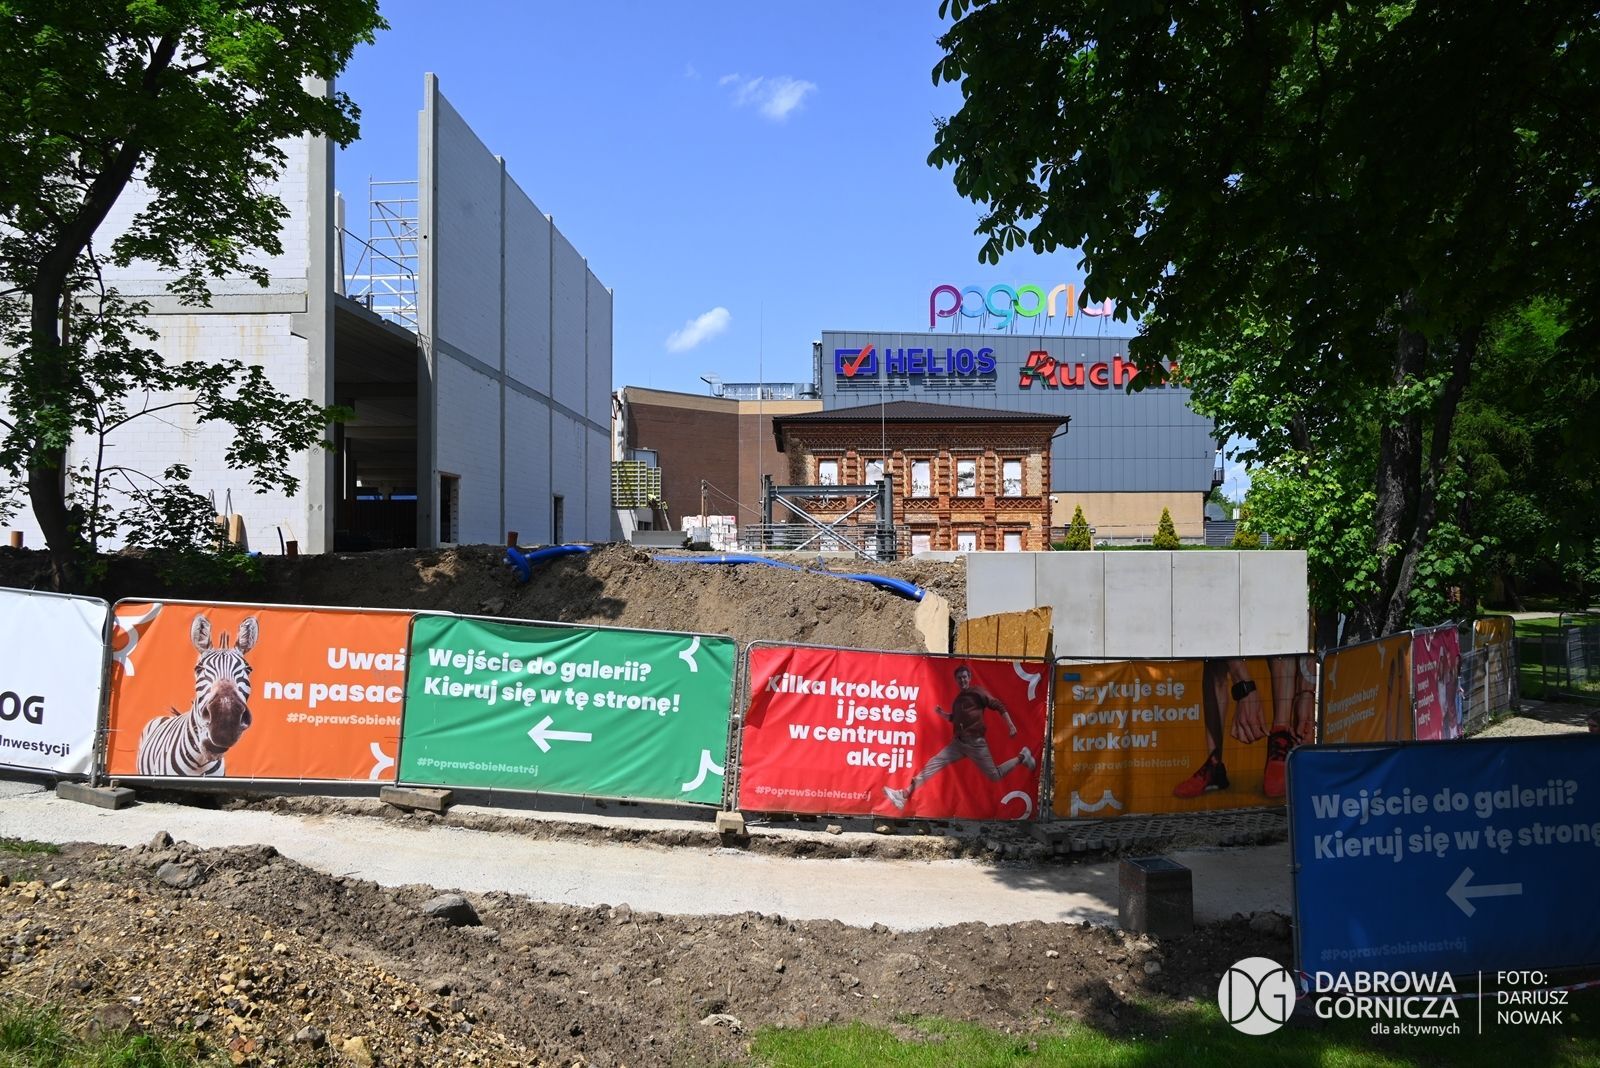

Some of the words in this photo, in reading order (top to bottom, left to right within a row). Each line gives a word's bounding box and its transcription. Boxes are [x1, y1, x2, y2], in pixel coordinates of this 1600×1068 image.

[886, 348, 997, 375] HELIOS
[1019, 350, 1190, 391] Auch
[428, 648, 523, 675] Wejście
[527, 653, 557, 675] do
[561, 658, 652, 683] galerii?
[264, 681, 303, 700] na
[309, 683, 403, 708] pasac
[424, 676, 498, 705] Kieruj
[501, 681, 535, 706] się
[541, 688, 562, 704] w
[565, 687, 592, 710] tę
[593, 691, 680, 716] stronę!
[765, 673, 825, 695] Kilka
[830, 677, 919, 701] kroków
[1071, 678, 1152, 705] Szykuje
[1155, 677, 1185, 700] się
[836, 699, 844, 720] i
[846, 701, 917, 726] jesteś
[1072, 709, 1128, 729] nowy
[1131, 704, 1200, 723] rekord
[789, 724, 810, 739] w
[813, 725, 915, 746] centrum
[1072, 730, 1158, 752] kroków!
[417, 757, 538, 777] #PoprawSobieNastrój
[847, 747, 914, 773] akcji!
[756, 786, 872, 801] #PoprawSobieNastrój
[1311, 787, 1428, 825] Wejście
[1433, 787, 1470, 814] do
[1473, 779, 1578, 818] galerii?
[1314, 827, 1403, 863] Kieruj
[1408, 825, 1450, 858] się
[1454, 830, 1479, 851] w
[1484, 827, 1513, 854] tę
